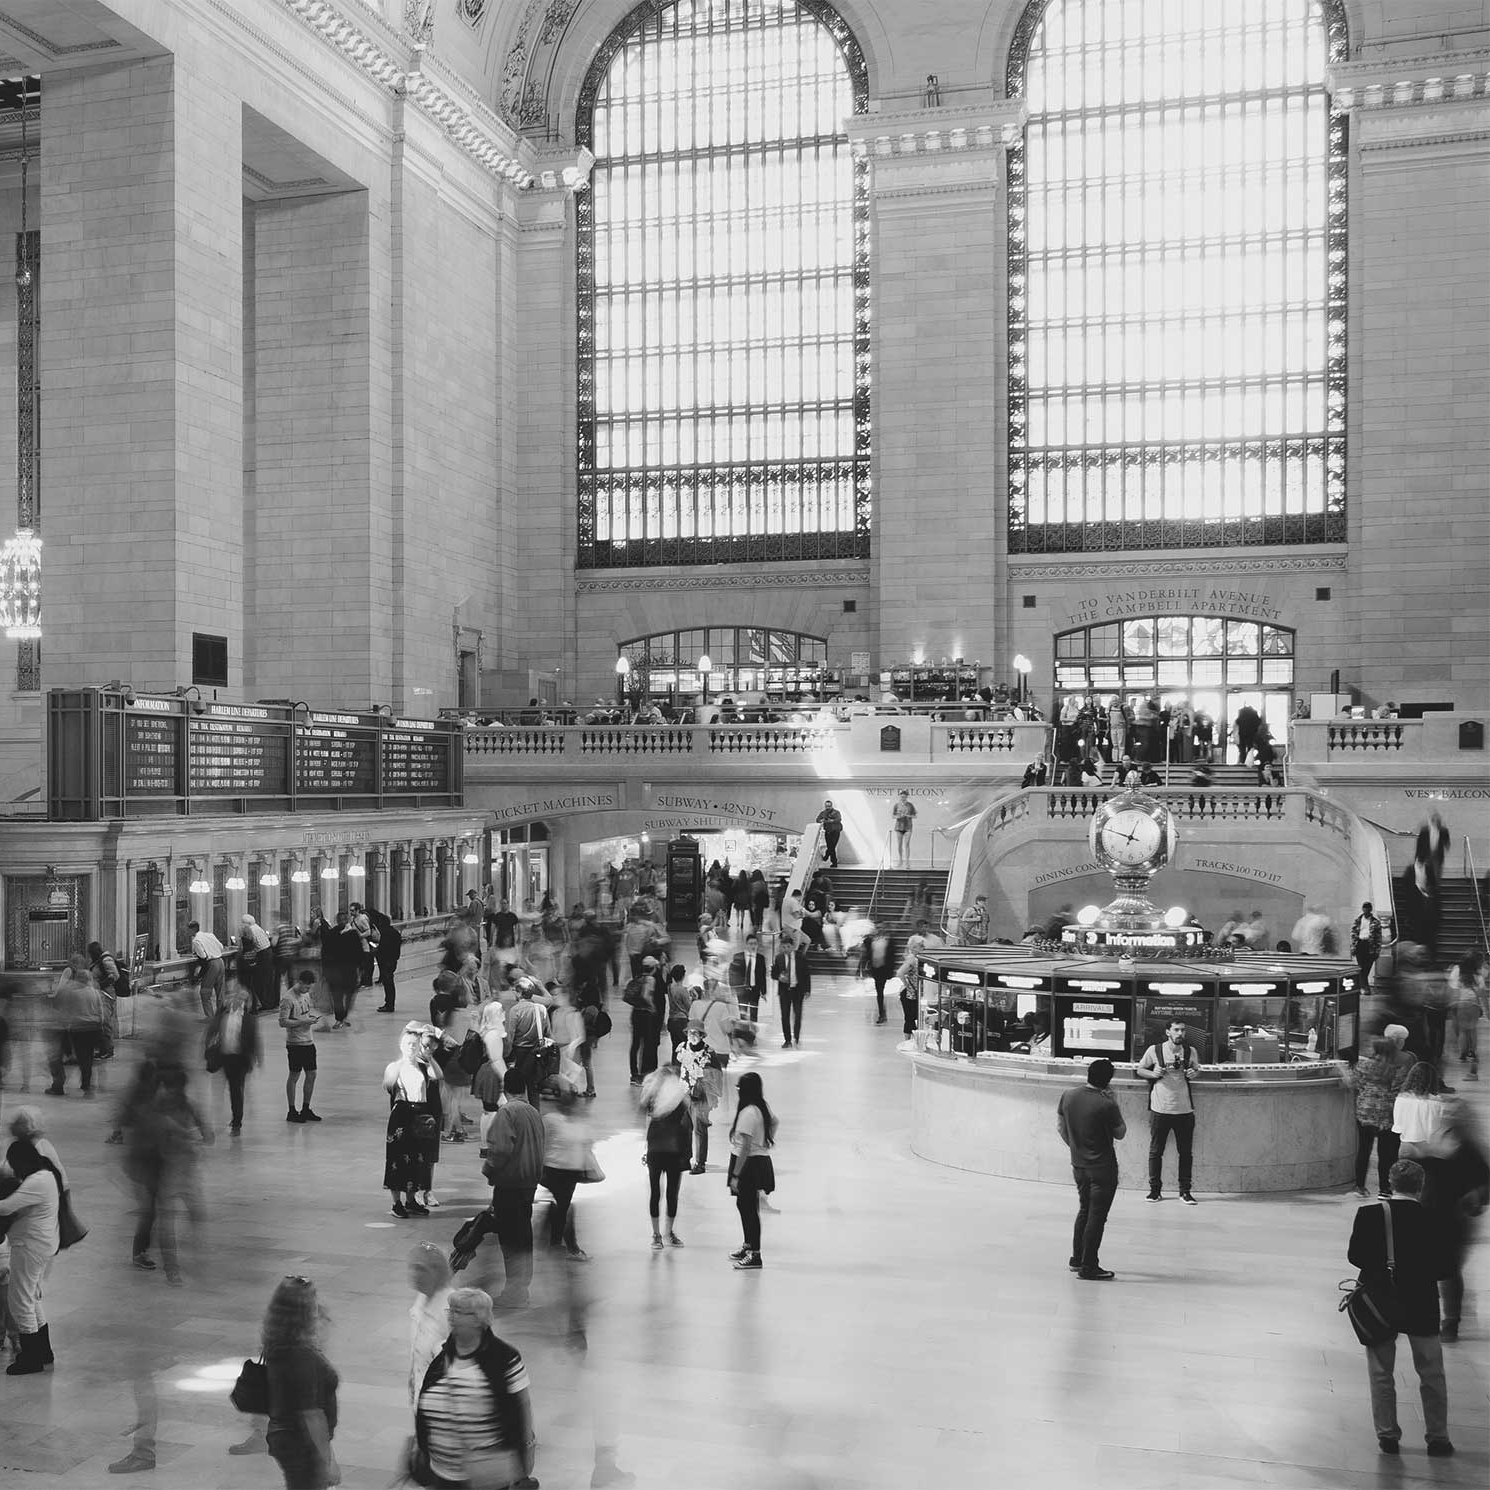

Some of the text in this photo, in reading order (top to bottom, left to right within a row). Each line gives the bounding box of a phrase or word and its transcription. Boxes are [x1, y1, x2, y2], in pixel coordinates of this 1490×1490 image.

[1078, 589, 1270, 610] TO VANDERBILT AVENUE
[1068, 600, 1282, 624] THE CAMPBELL APARTMENT
[866, 788, 894, 796] WEST
[1404, 790, 1438, 798] WEST
[494, 795, 613, 820] TICKET MACHINES
[657, 796, 776, 820] SUBWAY 42ND ST
[644, 818, 690, 830] SUBWAY
[1035, 868, 1074, 884] DINING
[1195, 858, 1282, 882] TRACKS 100 TO 117
[1105, 932, 1176, 946] Information
[1074, 1003, 1113, 1013] ARRIVALS
